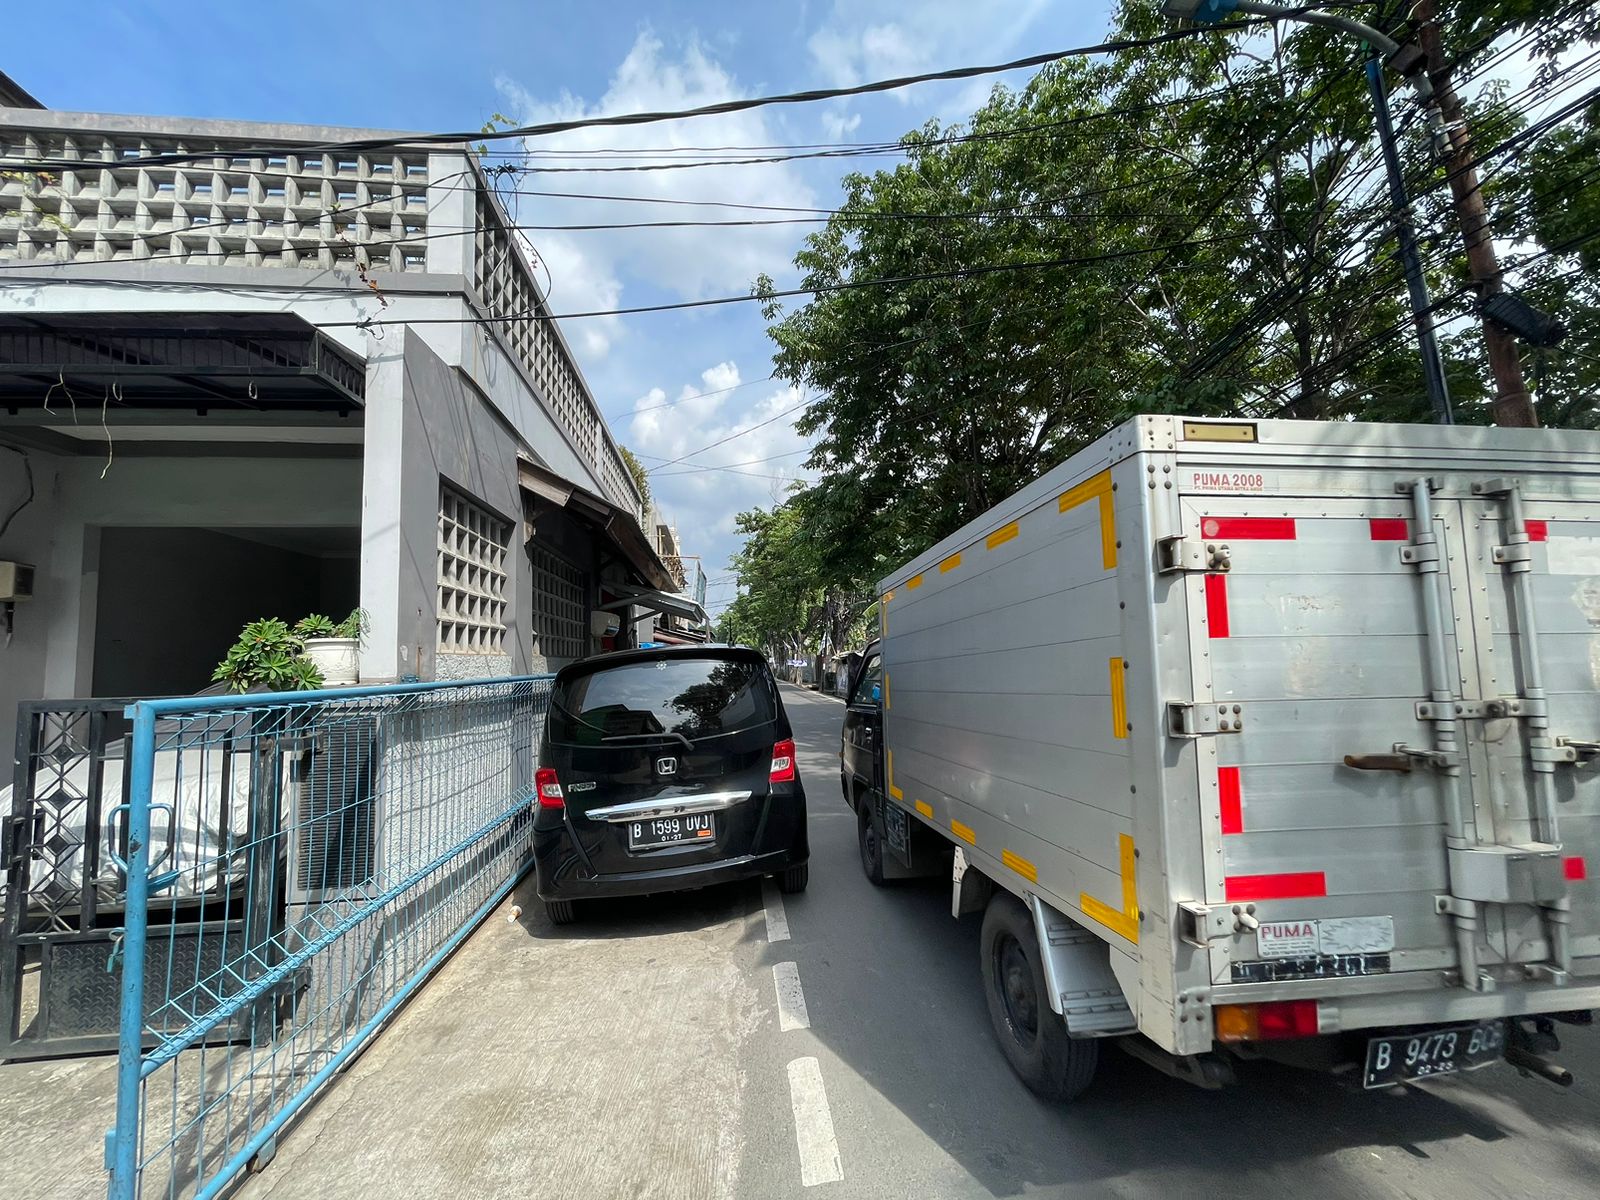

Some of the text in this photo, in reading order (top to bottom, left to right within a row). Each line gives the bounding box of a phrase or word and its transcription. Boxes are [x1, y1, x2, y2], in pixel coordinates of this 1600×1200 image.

[1193, 473, 1263, 487] PUMA 2008
[633, 814, 709, 838] B 1599 UVJ
[661, 833, 682, 842] 01-27
[1261, 923, 1314, 939] PUMA
[1376, 1042, 1392, 1071] B
[1405, 1032, 1457, 1066] 9473
